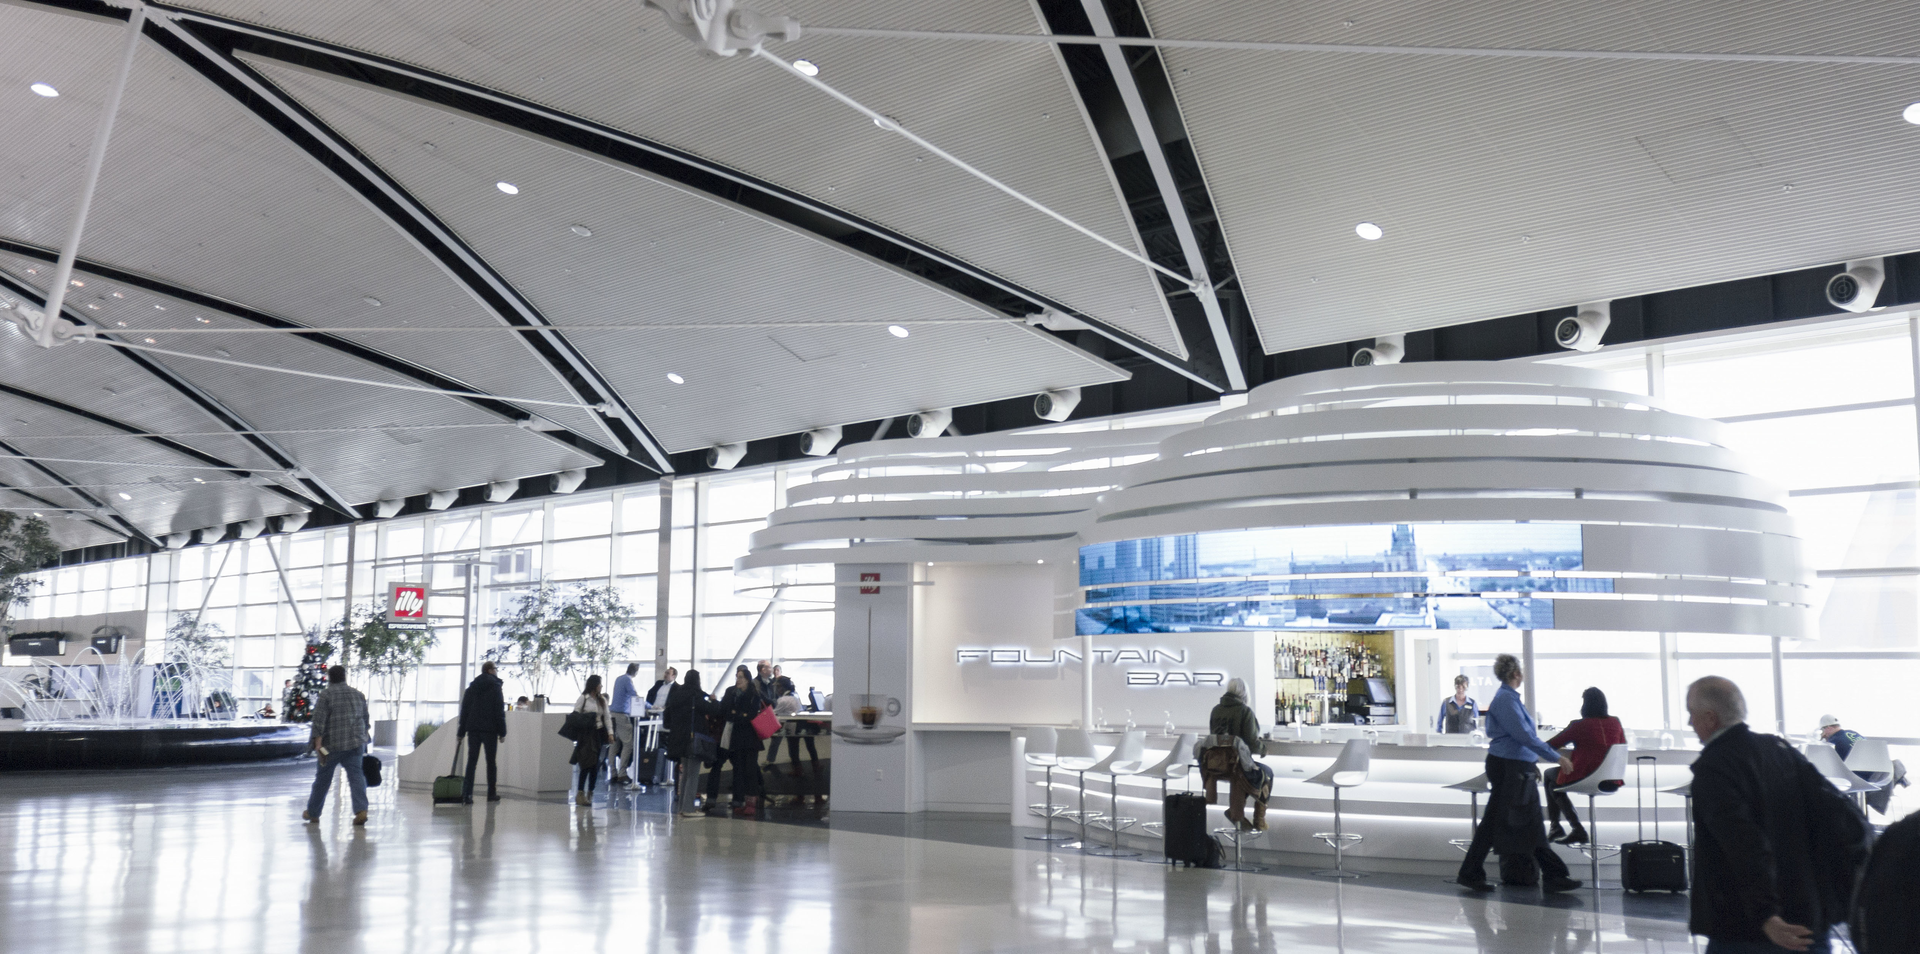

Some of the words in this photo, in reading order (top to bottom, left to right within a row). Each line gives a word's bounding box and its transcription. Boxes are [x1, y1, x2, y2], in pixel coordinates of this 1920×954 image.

[395, 590, 424, 616] illy
[956, 649, 1185, 664] FOUNTAIN
[1126, 671, 1225, 687] BAR
[1470, 676, 1493, 686] LTA
